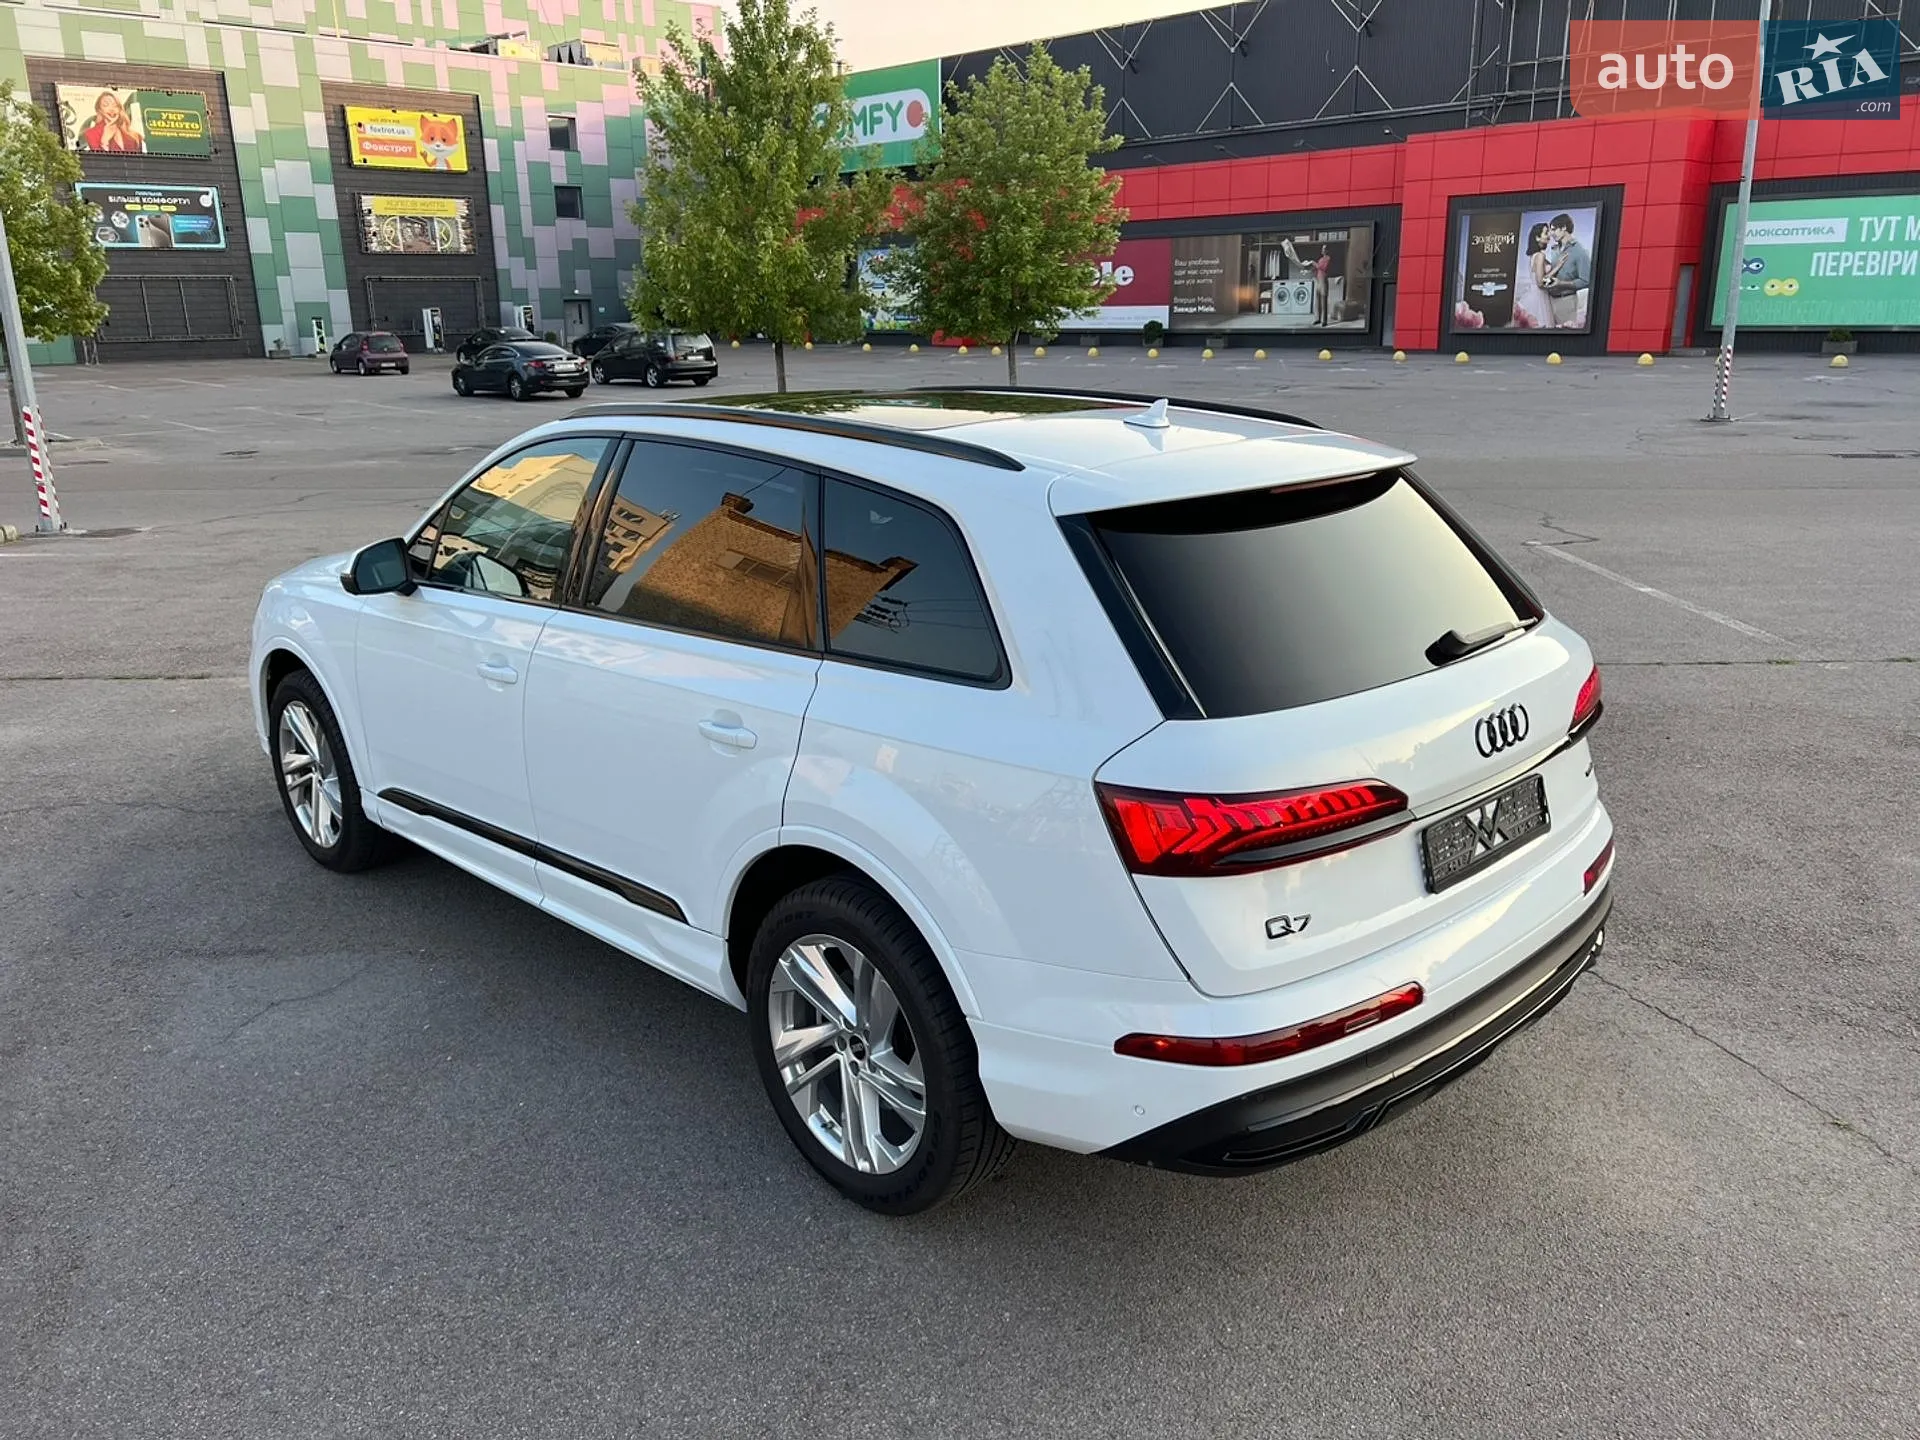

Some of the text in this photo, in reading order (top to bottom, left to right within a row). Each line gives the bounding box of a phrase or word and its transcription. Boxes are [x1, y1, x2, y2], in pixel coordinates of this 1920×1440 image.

[160, 112, 185, 121] УКР
[149, 118, 200, 129] ЗОЛОТО
[362, 141, 413, 154] Фокстрот
[108, 195, 141, 204] БІЛЬШЕ
[1746, 225, 1836, 238] ЛЮКСОПТИКА
[1859, 215, 1902, 242] ТУТ
[1810, 249, 1919, 277] ПЕРЕВІРИ
[1264, 913, 1312, 940] Q7
